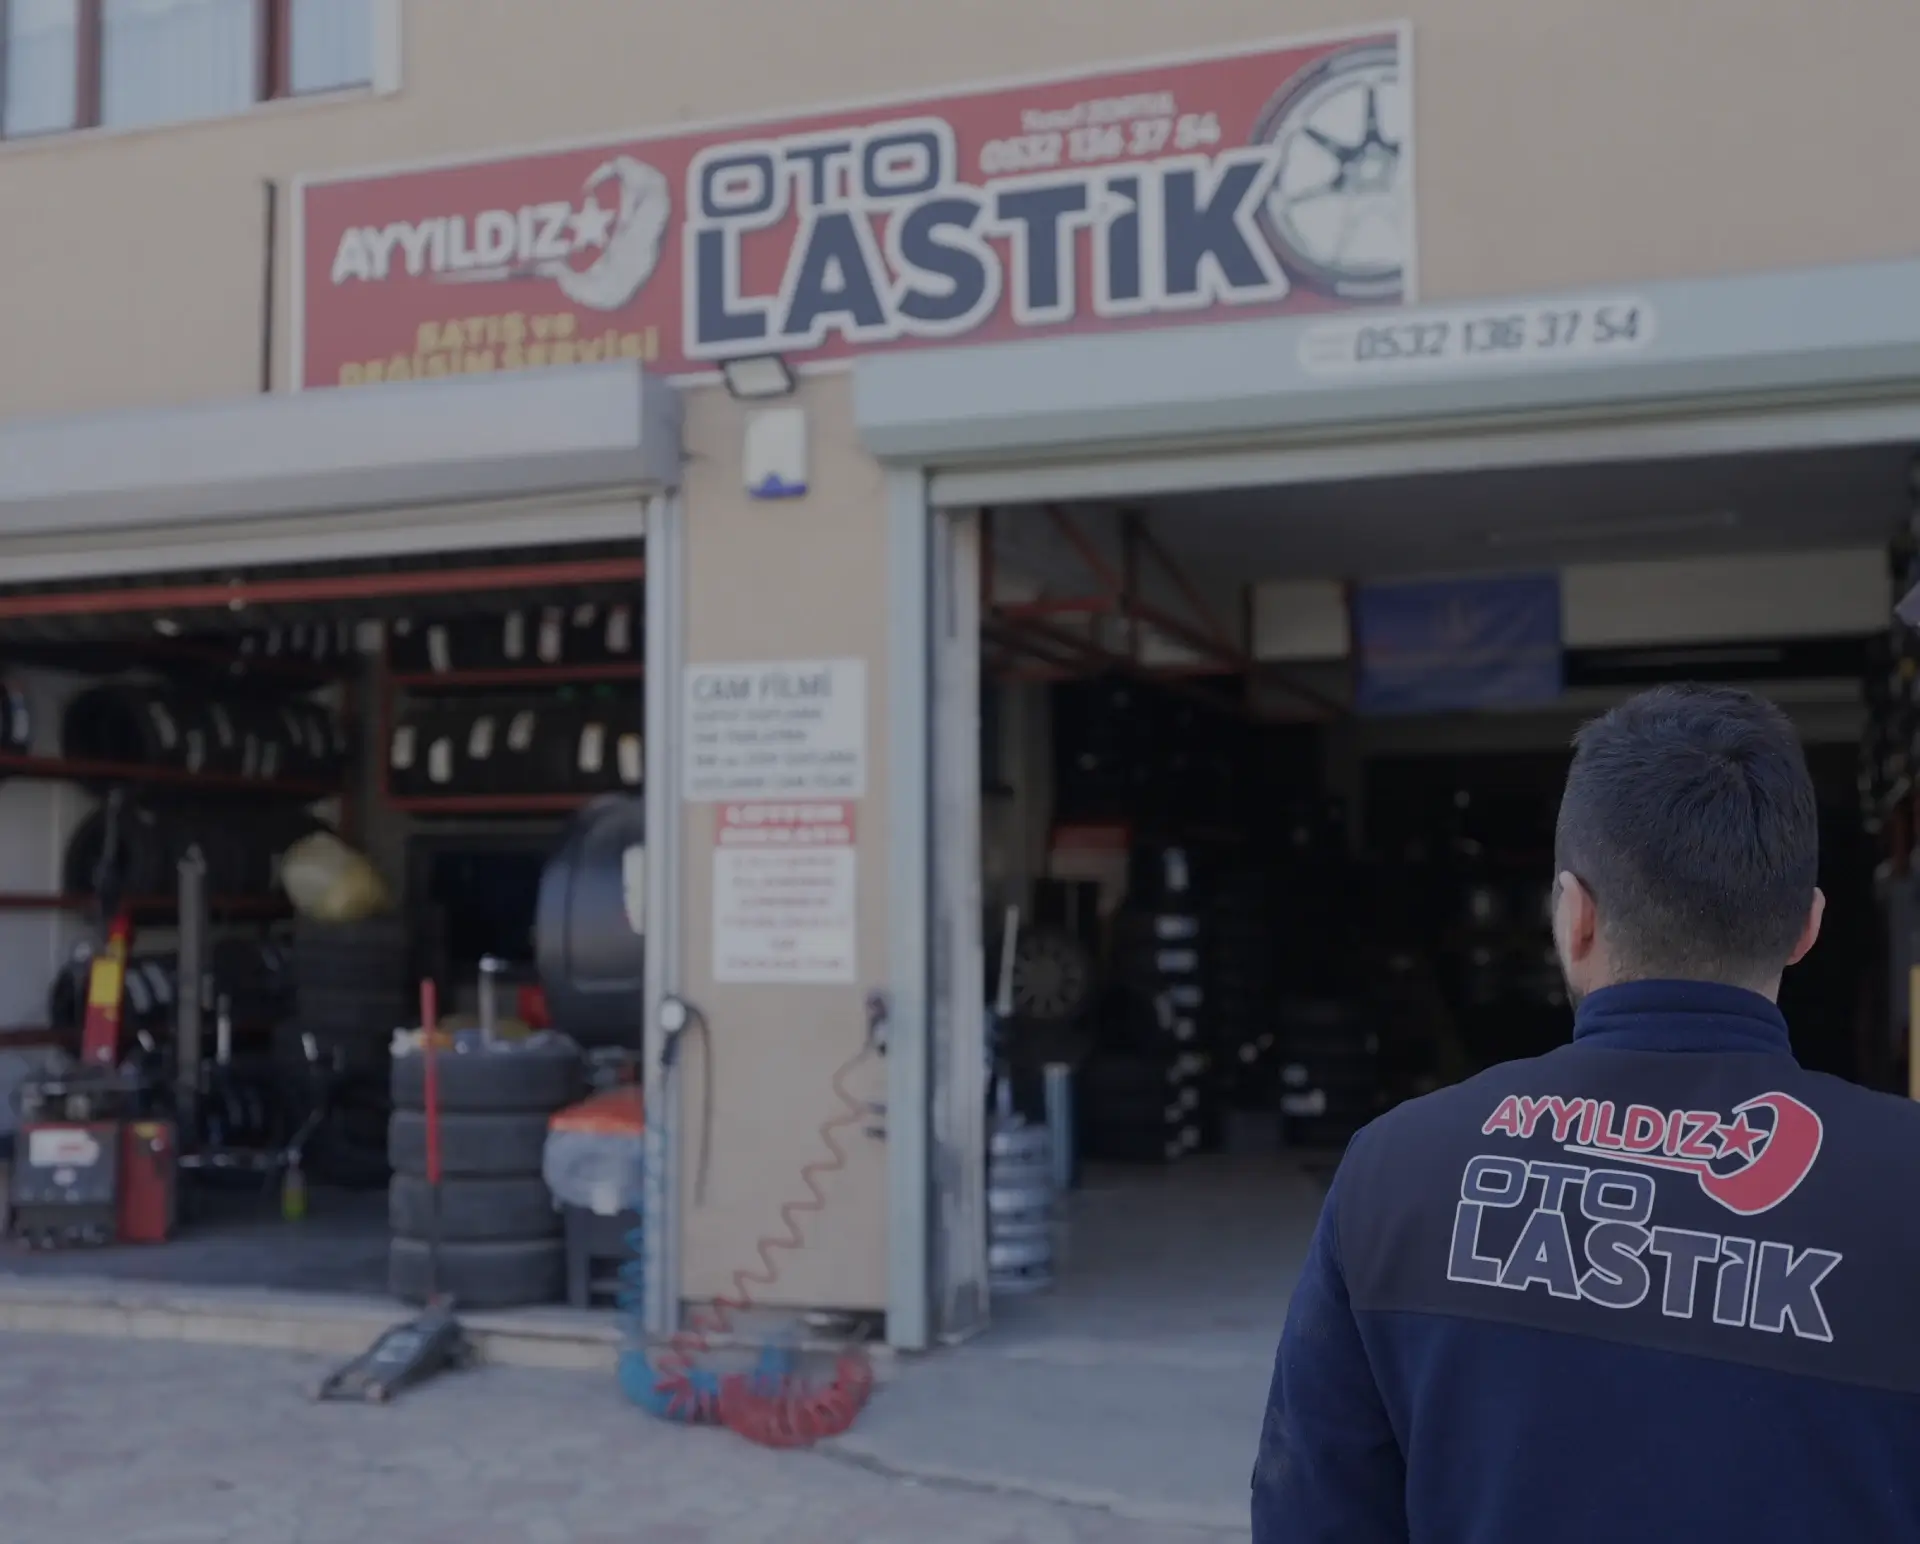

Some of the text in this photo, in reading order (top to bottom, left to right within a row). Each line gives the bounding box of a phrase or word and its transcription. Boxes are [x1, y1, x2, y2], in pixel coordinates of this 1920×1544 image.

[698, 128, 945, 221] OTO
[331, 201, 572, 285] AYYILDIZ
[1355, 321, 1451, 362] 0532
[1463, 314, 1526, 354] 136
[1536, 309, 1582, 348] 37
[1593, 305, 1641, 343] 54
[1481, 1095, 1722, 1158] AYYILDIZ
[1460, 1154, 1656, 1225] OTO
